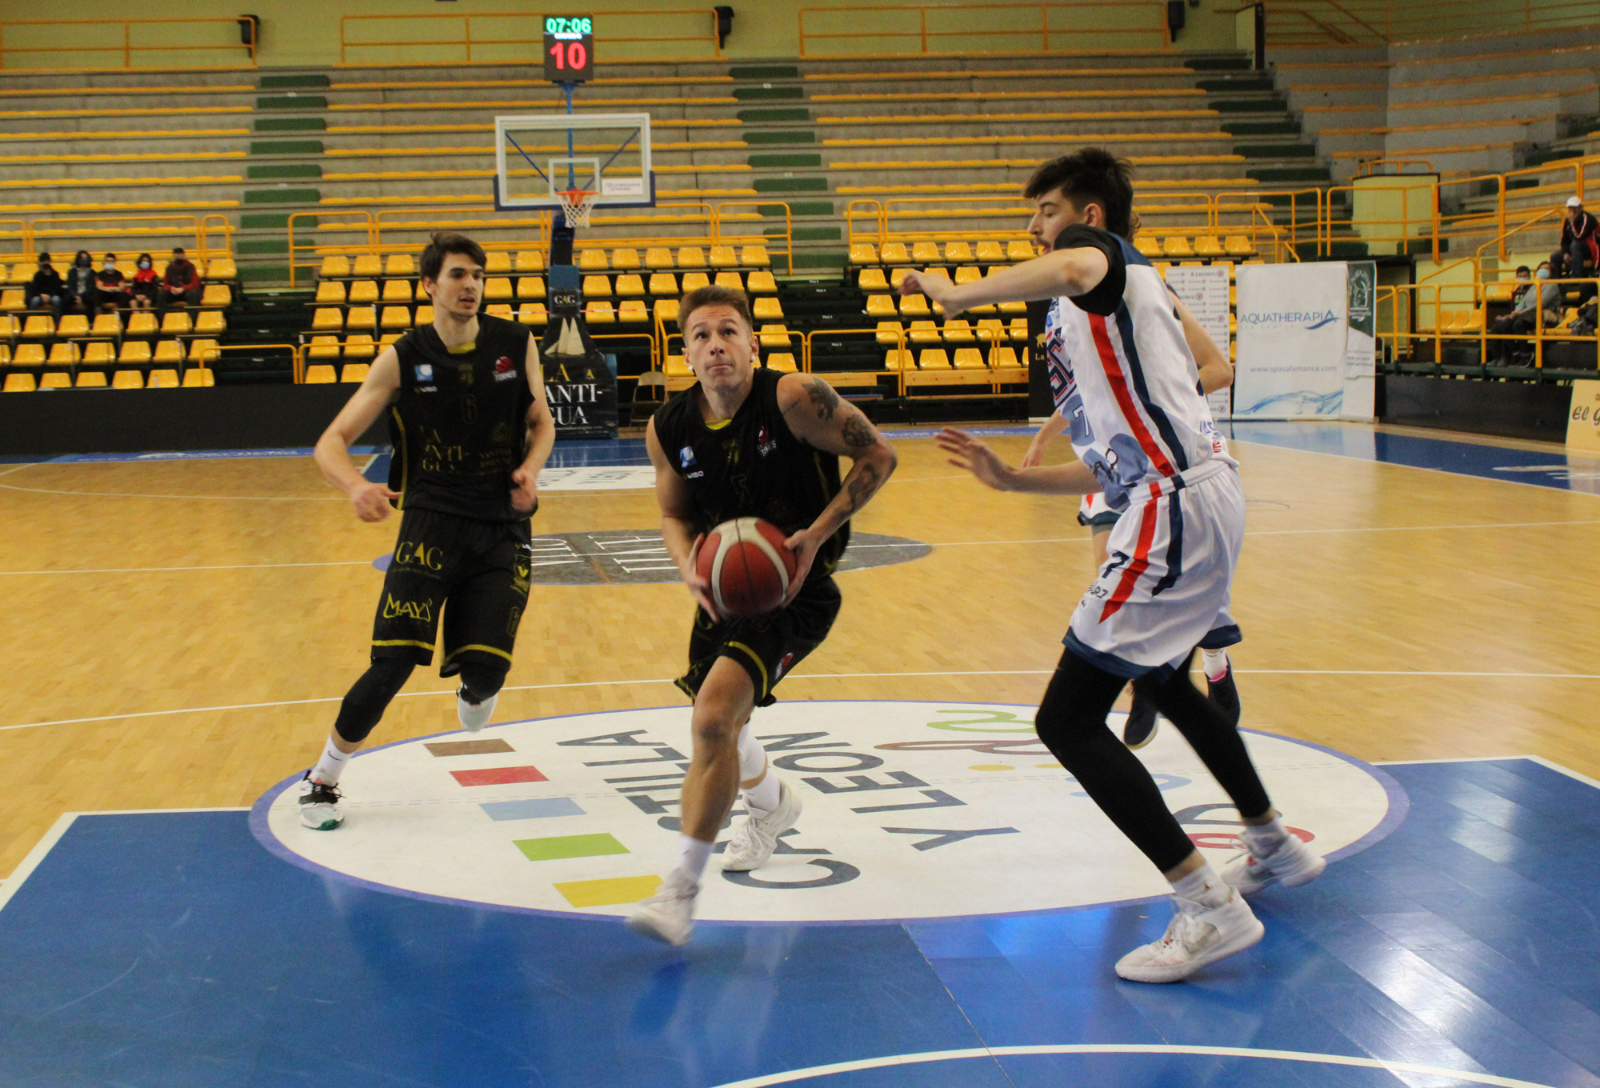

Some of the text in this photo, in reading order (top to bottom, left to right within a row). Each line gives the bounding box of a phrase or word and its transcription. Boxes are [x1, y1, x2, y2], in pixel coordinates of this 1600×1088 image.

[546, 17, 592, 33] 07:06
[550, 41, 587, 70] 10
[1240, 309, 1337, 324] AQUATHERAPIA
[1250, 365, 1337, 373] www.spasalamanca.com
[396, 541, 444, 571] GAG
[1102, 551, 1130, 579] 7
[880, 827, 1021, 851] Y
